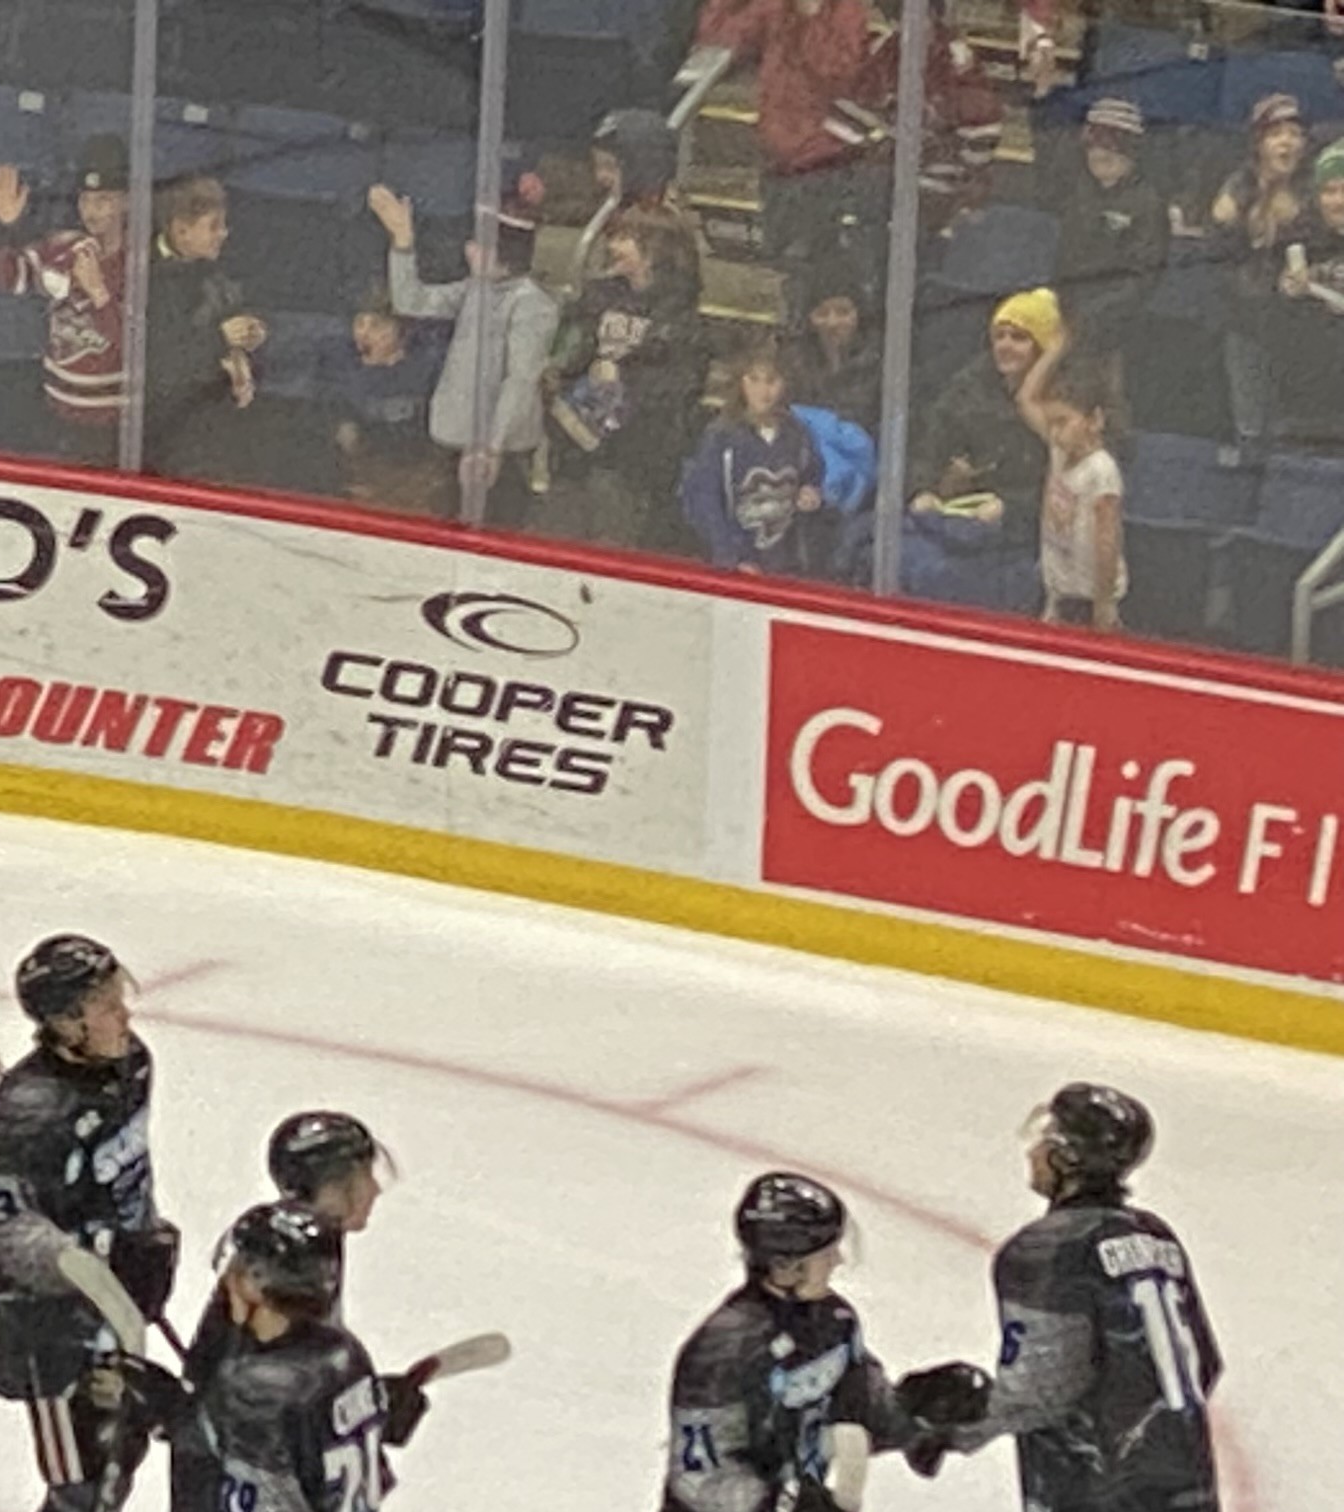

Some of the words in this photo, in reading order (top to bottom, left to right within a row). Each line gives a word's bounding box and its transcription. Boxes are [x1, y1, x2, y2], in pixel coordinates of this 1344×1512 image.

[320, 650, 676, 751] COOPER
[366, 712, 616, 796] TIRES
[789, 706, 1222, 888] GoodLife
